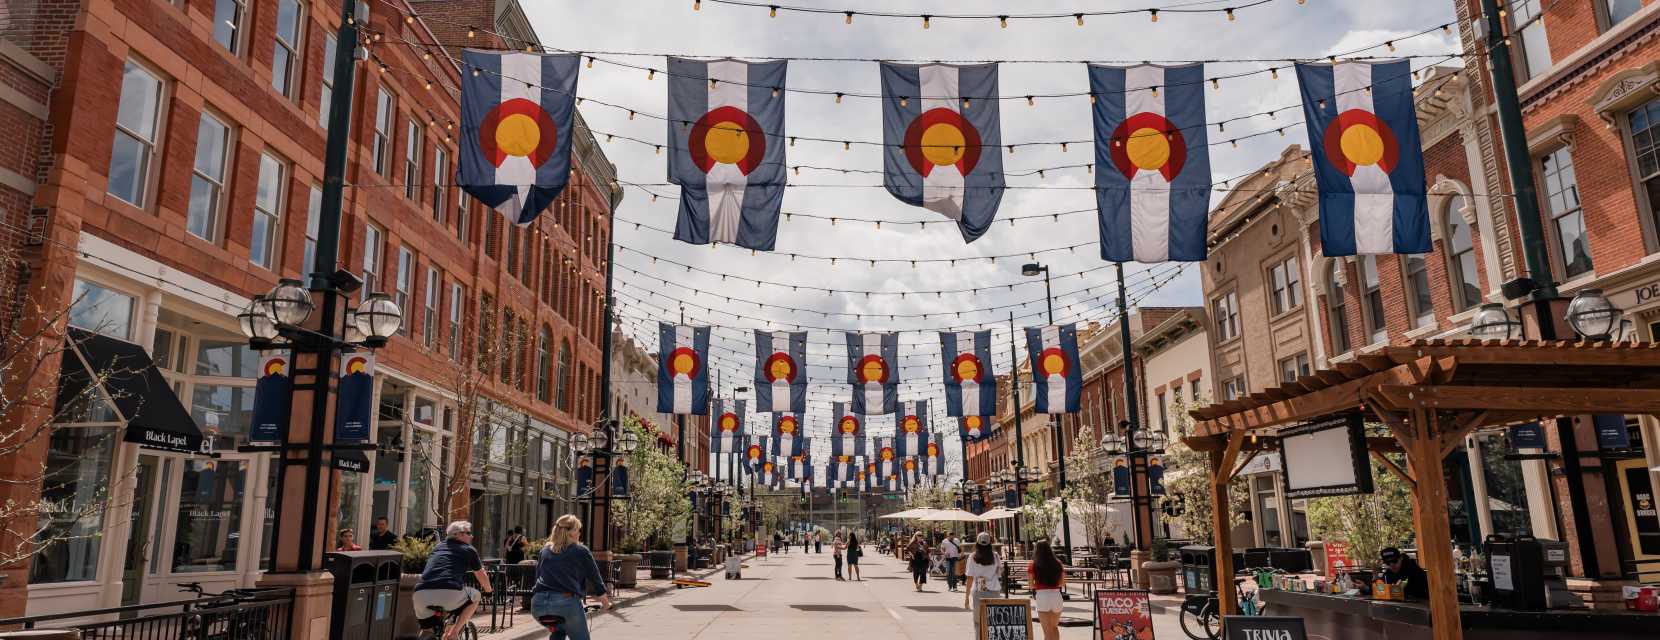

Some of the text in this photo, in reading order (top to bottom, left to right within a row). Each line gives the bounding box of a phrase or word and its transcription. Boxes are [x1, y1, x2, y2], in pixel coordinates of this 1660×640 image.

[1635, 284, 1659, 304] JOE
[145, 430, 166, 443] Black
[167, 434, 187, 446] Lapel
[1099, 597, 1133, 608] TACO
[986, 606, 1026, 625] RUSSIAN
[1100, 607, 1134, 615] TUESDAY
[988, 625, 1027, 640] RIVER
[1241, 629, 1293, 640] TRIVIA
